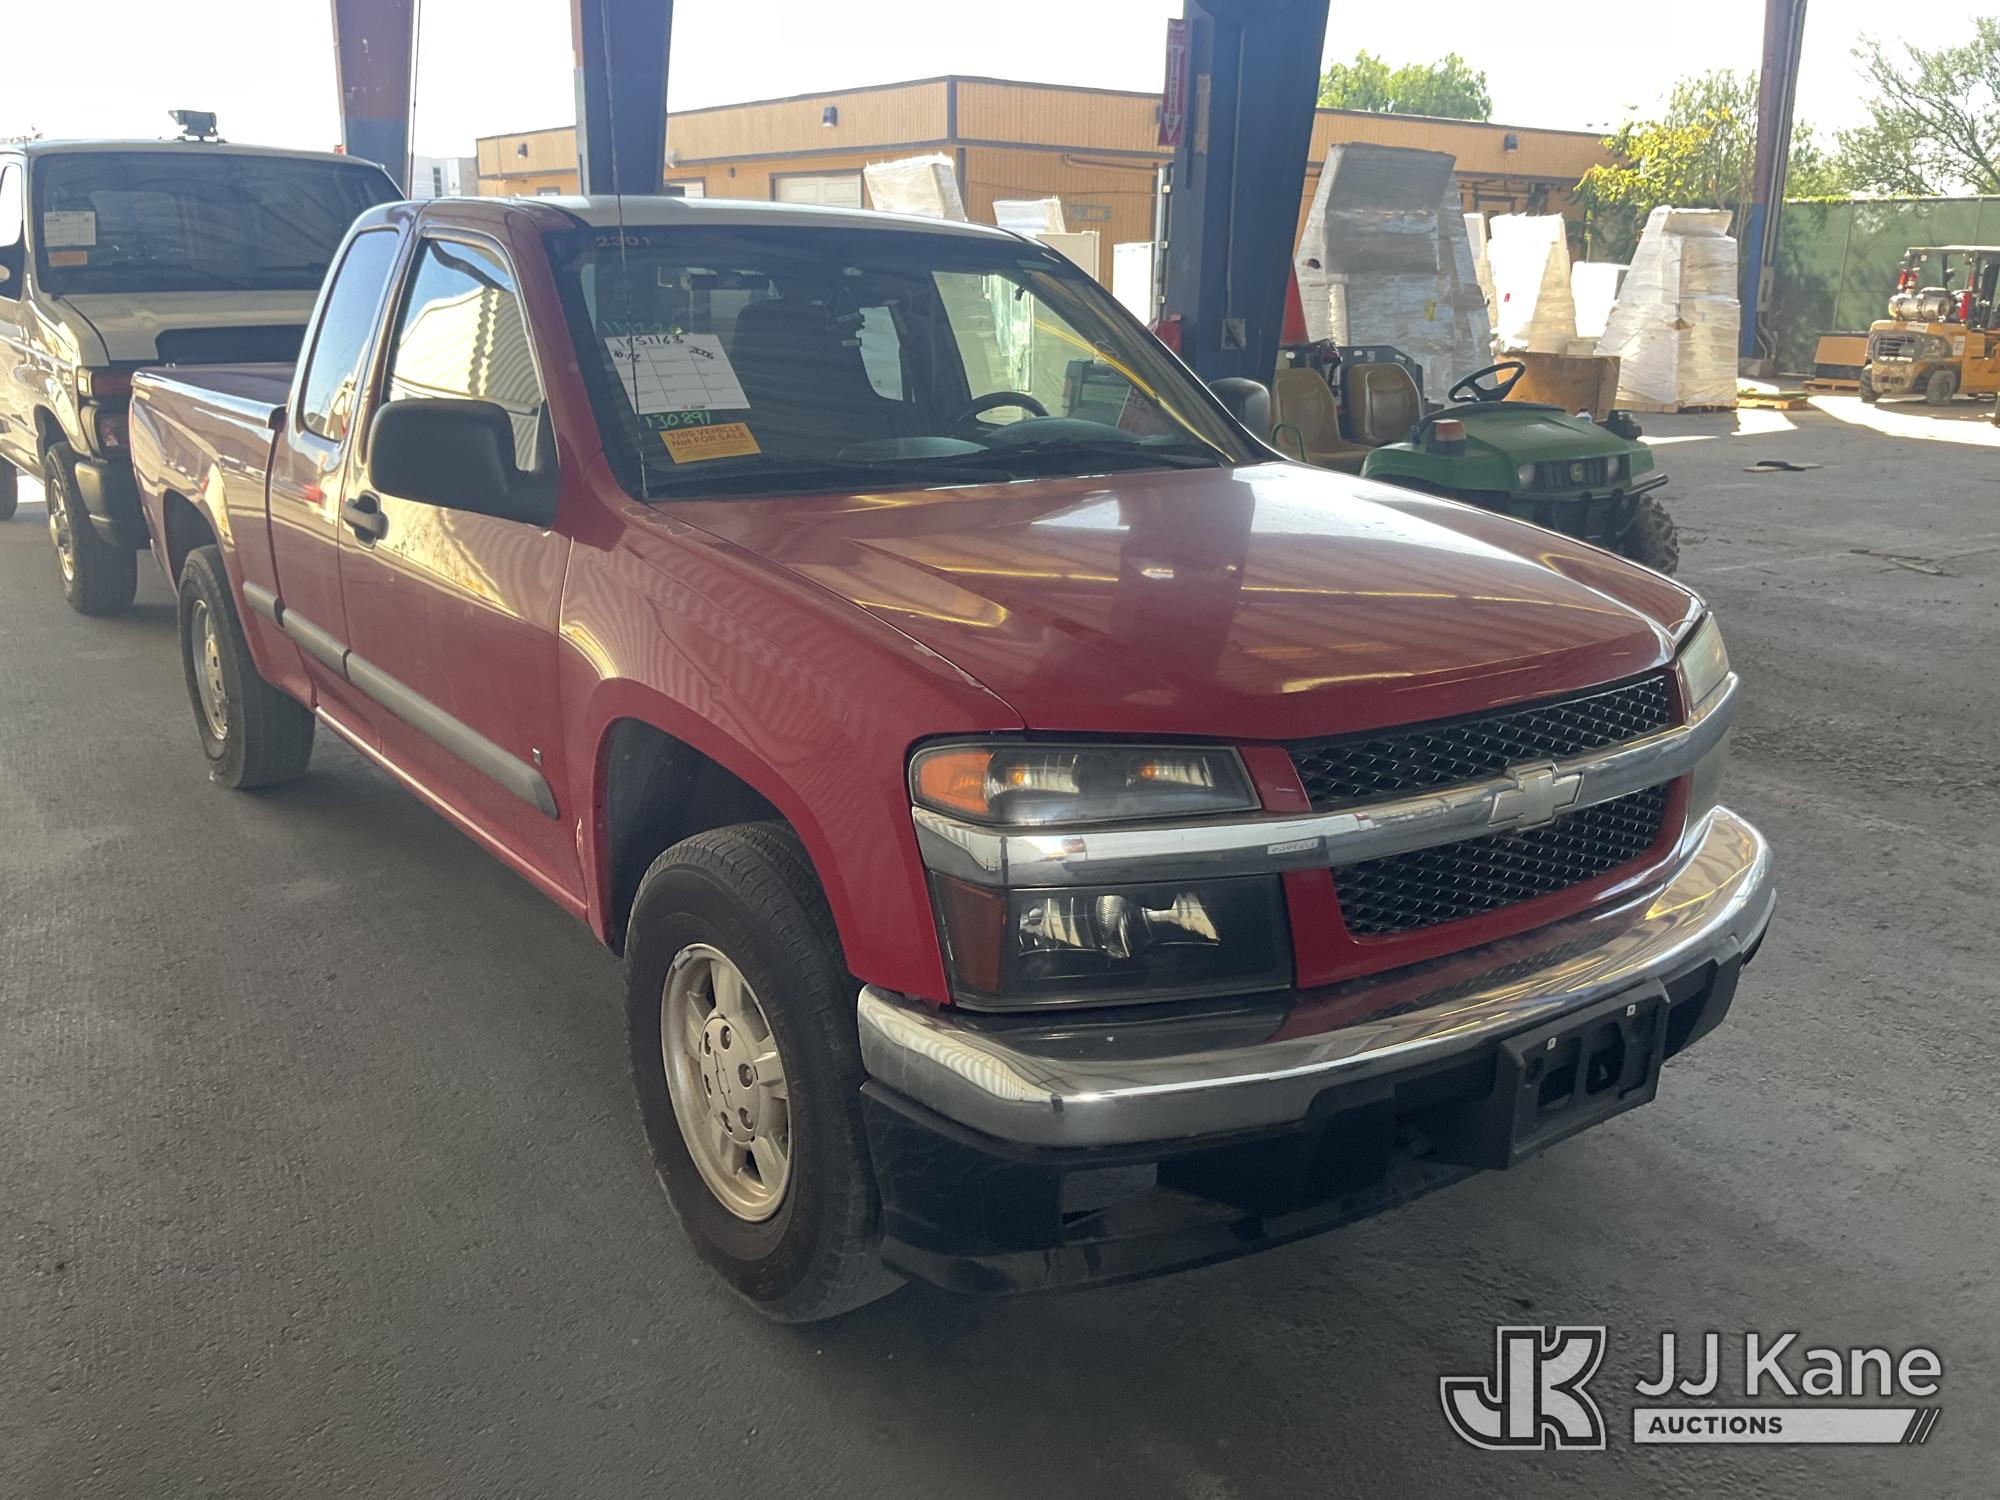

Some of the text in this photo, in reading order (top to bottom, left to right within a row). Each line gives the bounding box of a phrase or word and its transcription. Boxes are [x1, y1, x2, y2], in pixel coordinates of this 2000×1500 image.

[669, 425, 741, 441] THIS VEHICLE
[694, 435, 716, 445] FOR
[718, 431, 746, 441] SALE
